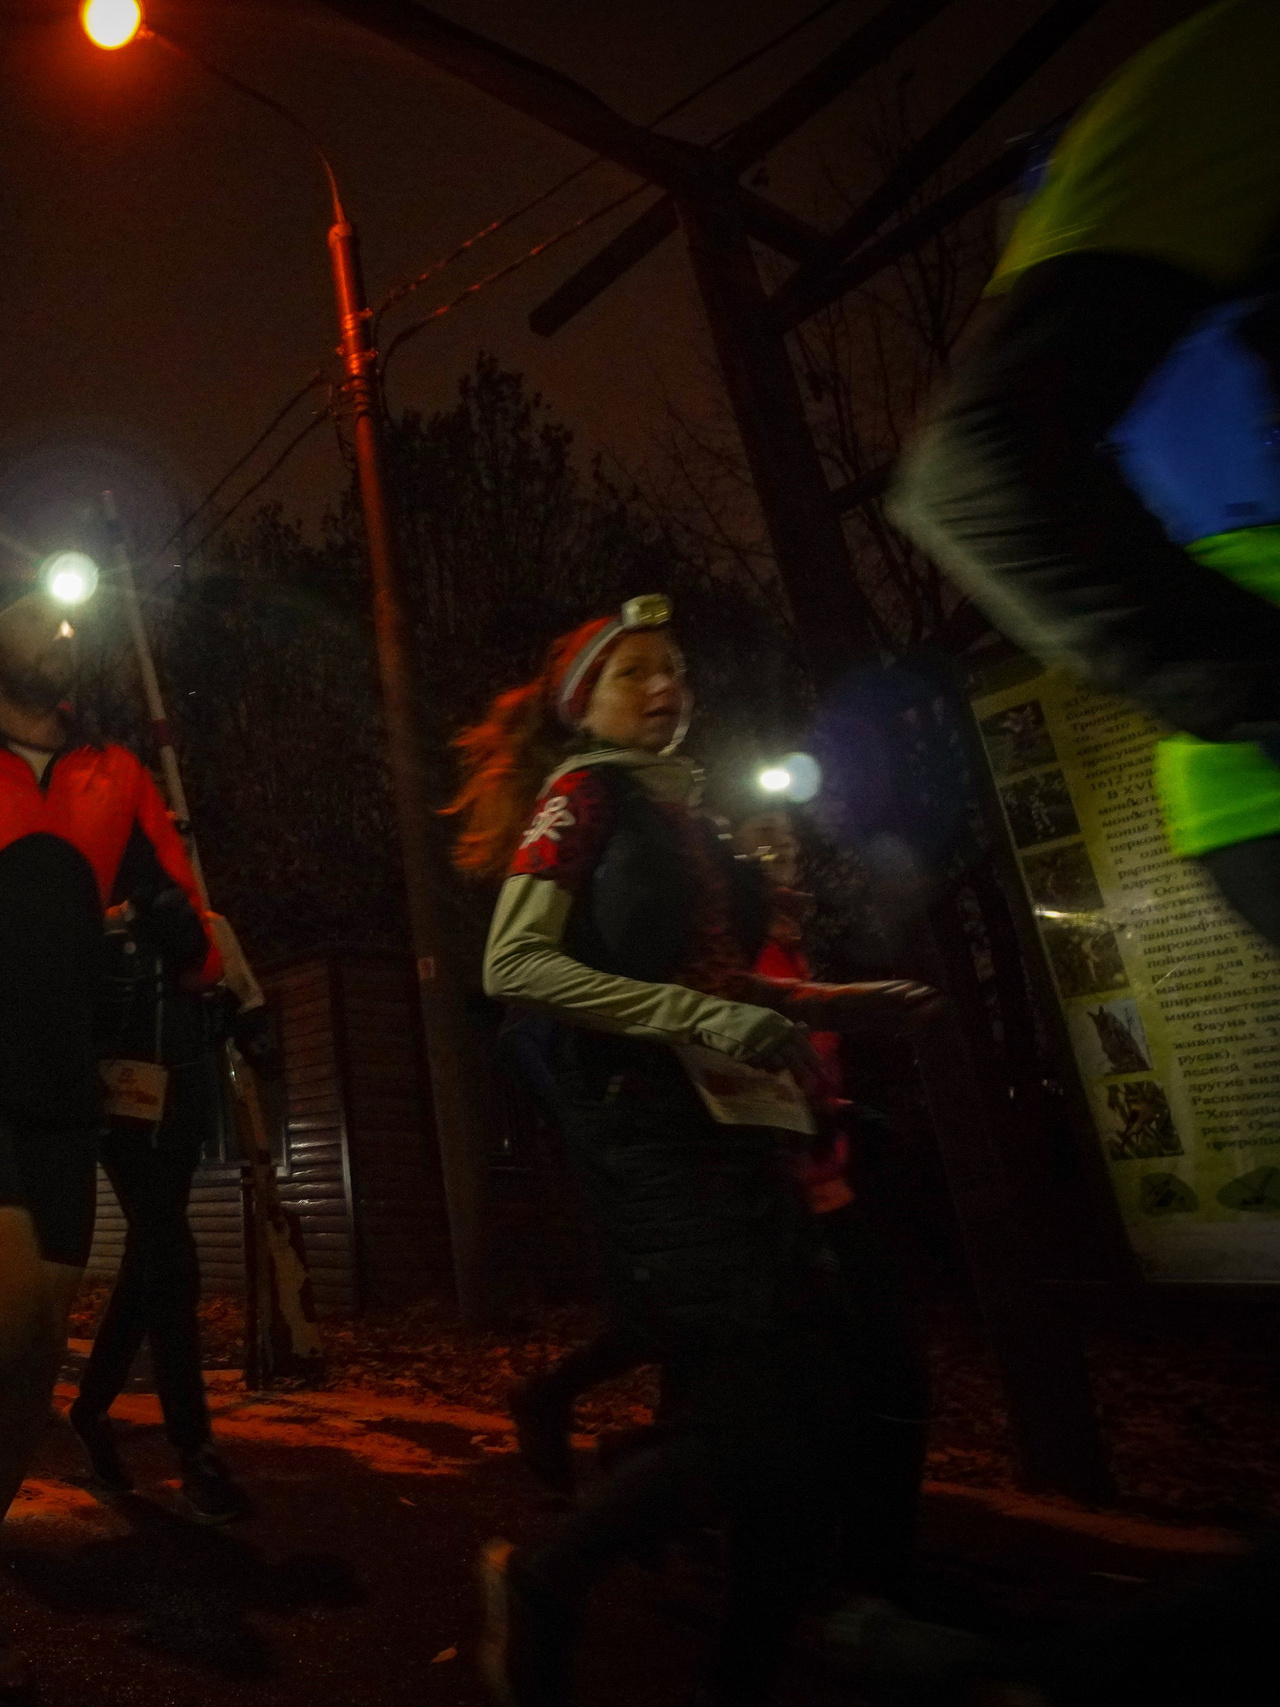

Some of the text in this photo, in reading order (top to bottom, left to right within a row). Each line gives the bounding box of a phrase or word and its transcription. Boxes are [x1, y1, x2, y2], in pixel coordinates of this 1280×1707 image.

[1090, 774, 1124, 791] 1612
[1215, 959, 1245, 973] для
[1192, 1018, 1247, 1033] Фауна
